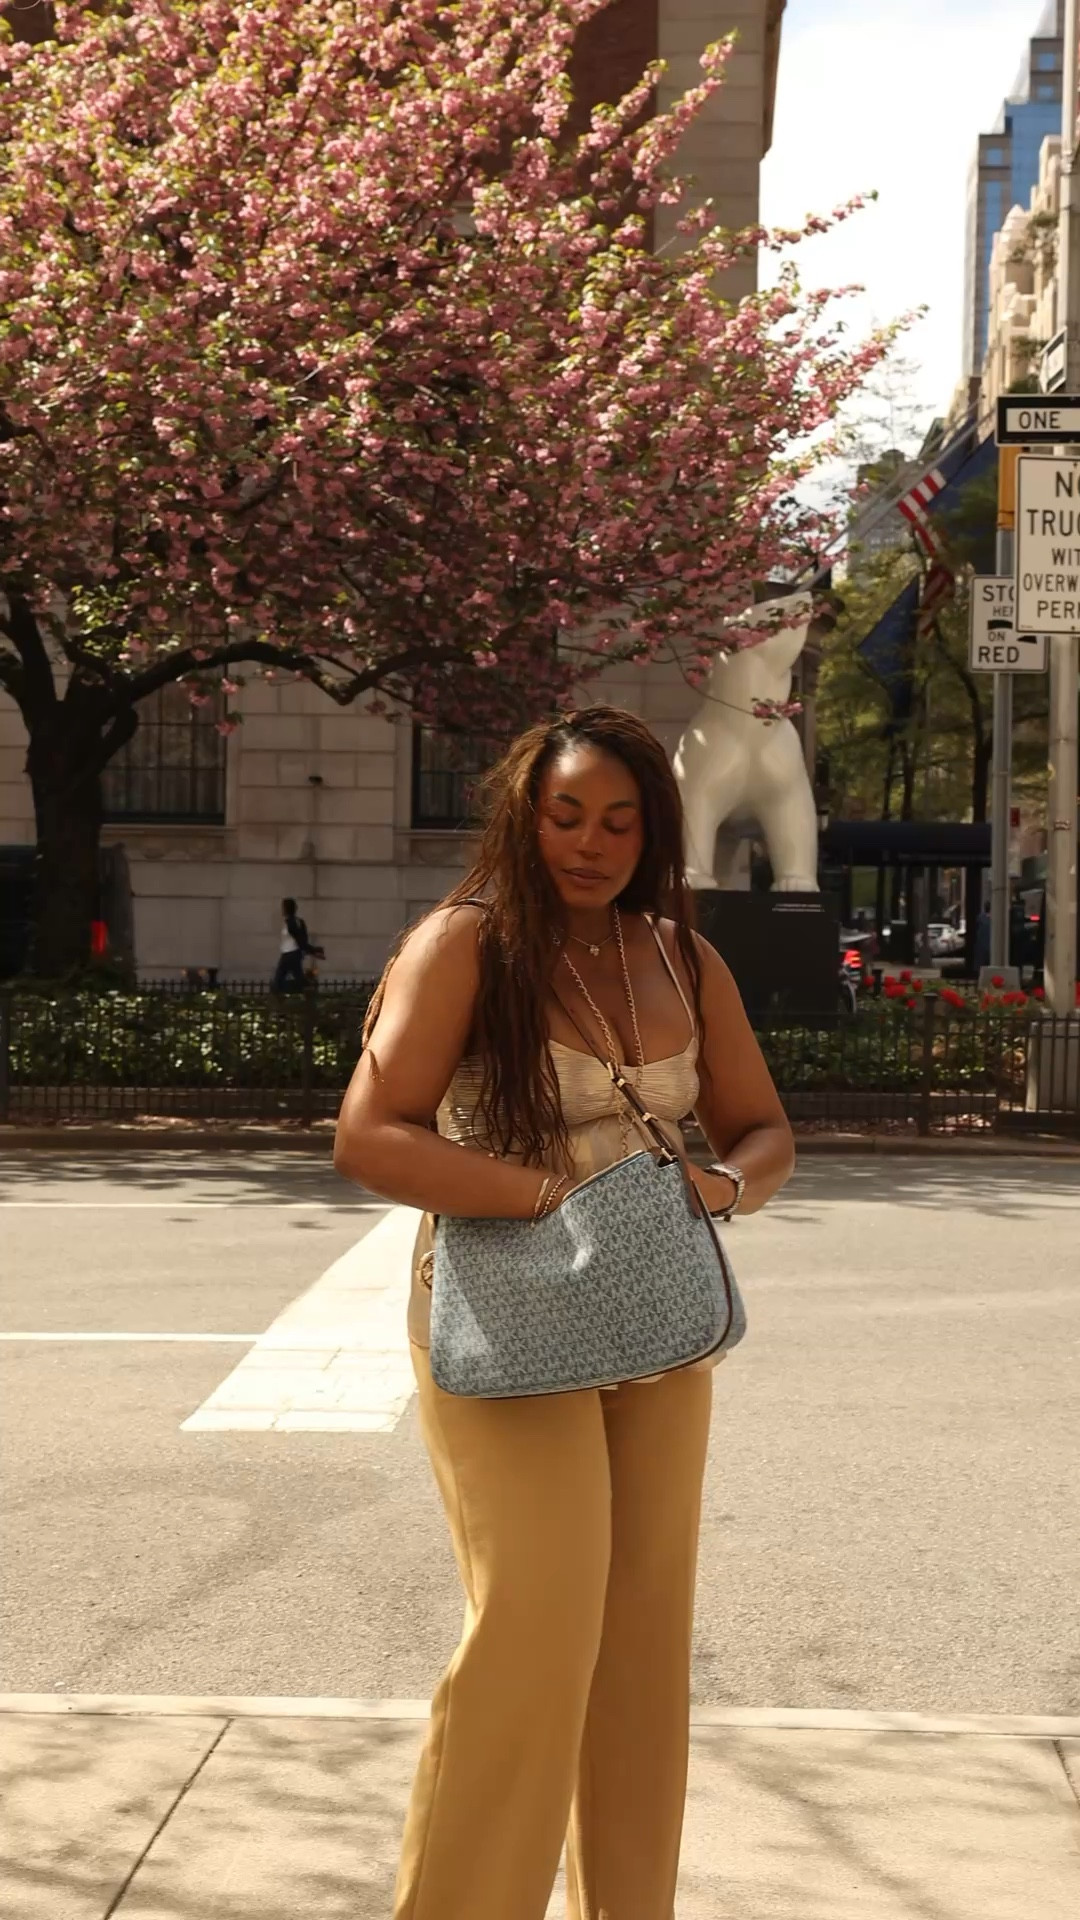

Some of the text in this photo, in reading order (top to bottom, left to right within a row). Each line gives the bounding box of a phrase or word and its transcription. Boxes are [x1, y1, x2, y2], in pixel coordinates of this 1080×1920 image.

[1018, 411, 1061, 429] ONE
[1055, 471, 1080, 498] N
[1026, 508, 1080, 537] TRU
[1037, 600, 1080, 619] PER
[988, 631, 1005, 642] ON
[978, 646, 1019, 663] RED
